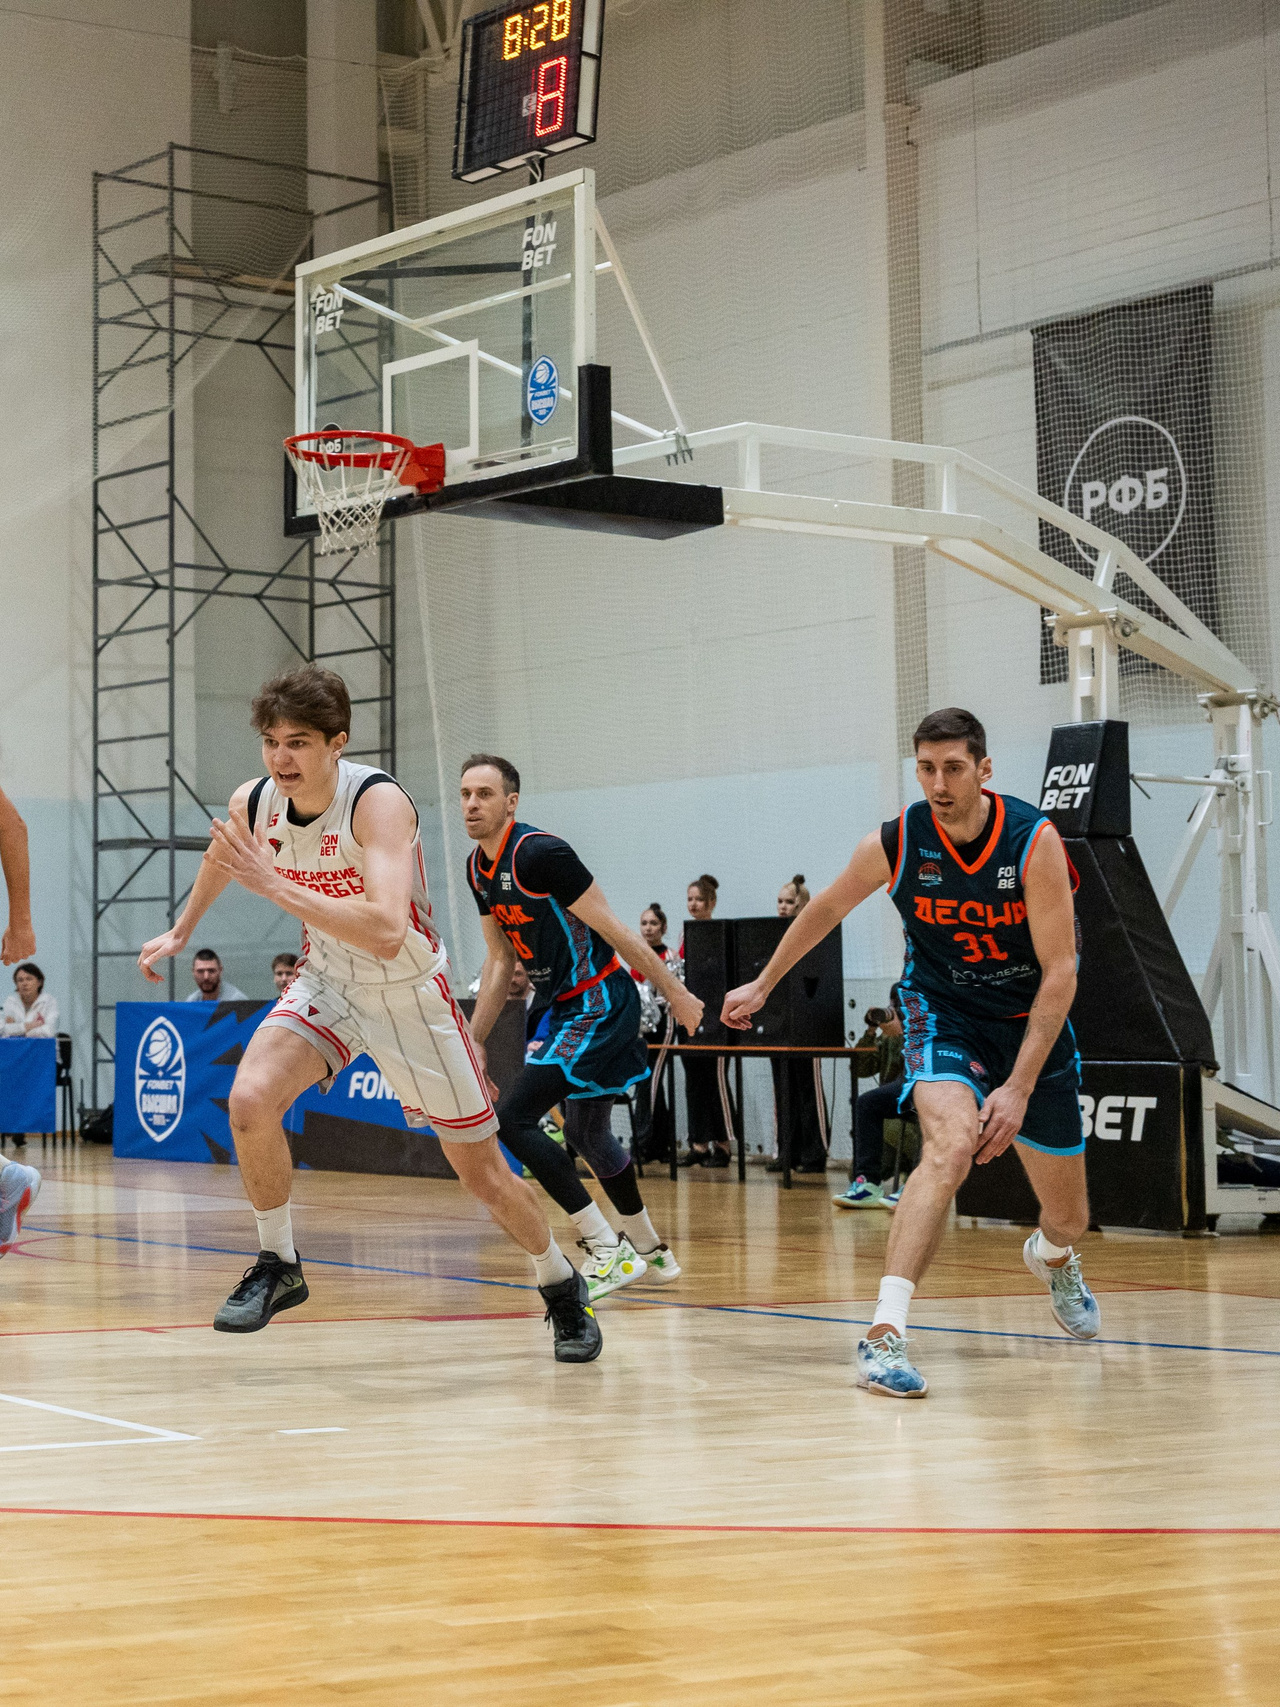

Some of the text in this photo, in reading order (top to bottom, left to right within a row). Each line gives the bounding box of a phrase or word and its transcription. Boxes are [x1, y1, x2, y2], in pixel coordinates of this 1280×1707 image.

[502, 0, 571, 60] 8:28
[535, 55, 567, 137] 8
[521, 221, 557, 249] FON
[521, 243, 557, 271] BET
[315, 290, 344, 315] FON
[315, 309, 345, 335] BET
[1082, 467, 1169, 520] РФБ
[1044, 762, 1095, 788] FON
[1040, 786, 1091, 811] BET
[320, 846, 338, 857] BET
[918, 848, 942, 860] TEAM
[997, 877, 1016, 889] BE
[953, 931, 1009, 963] 31
